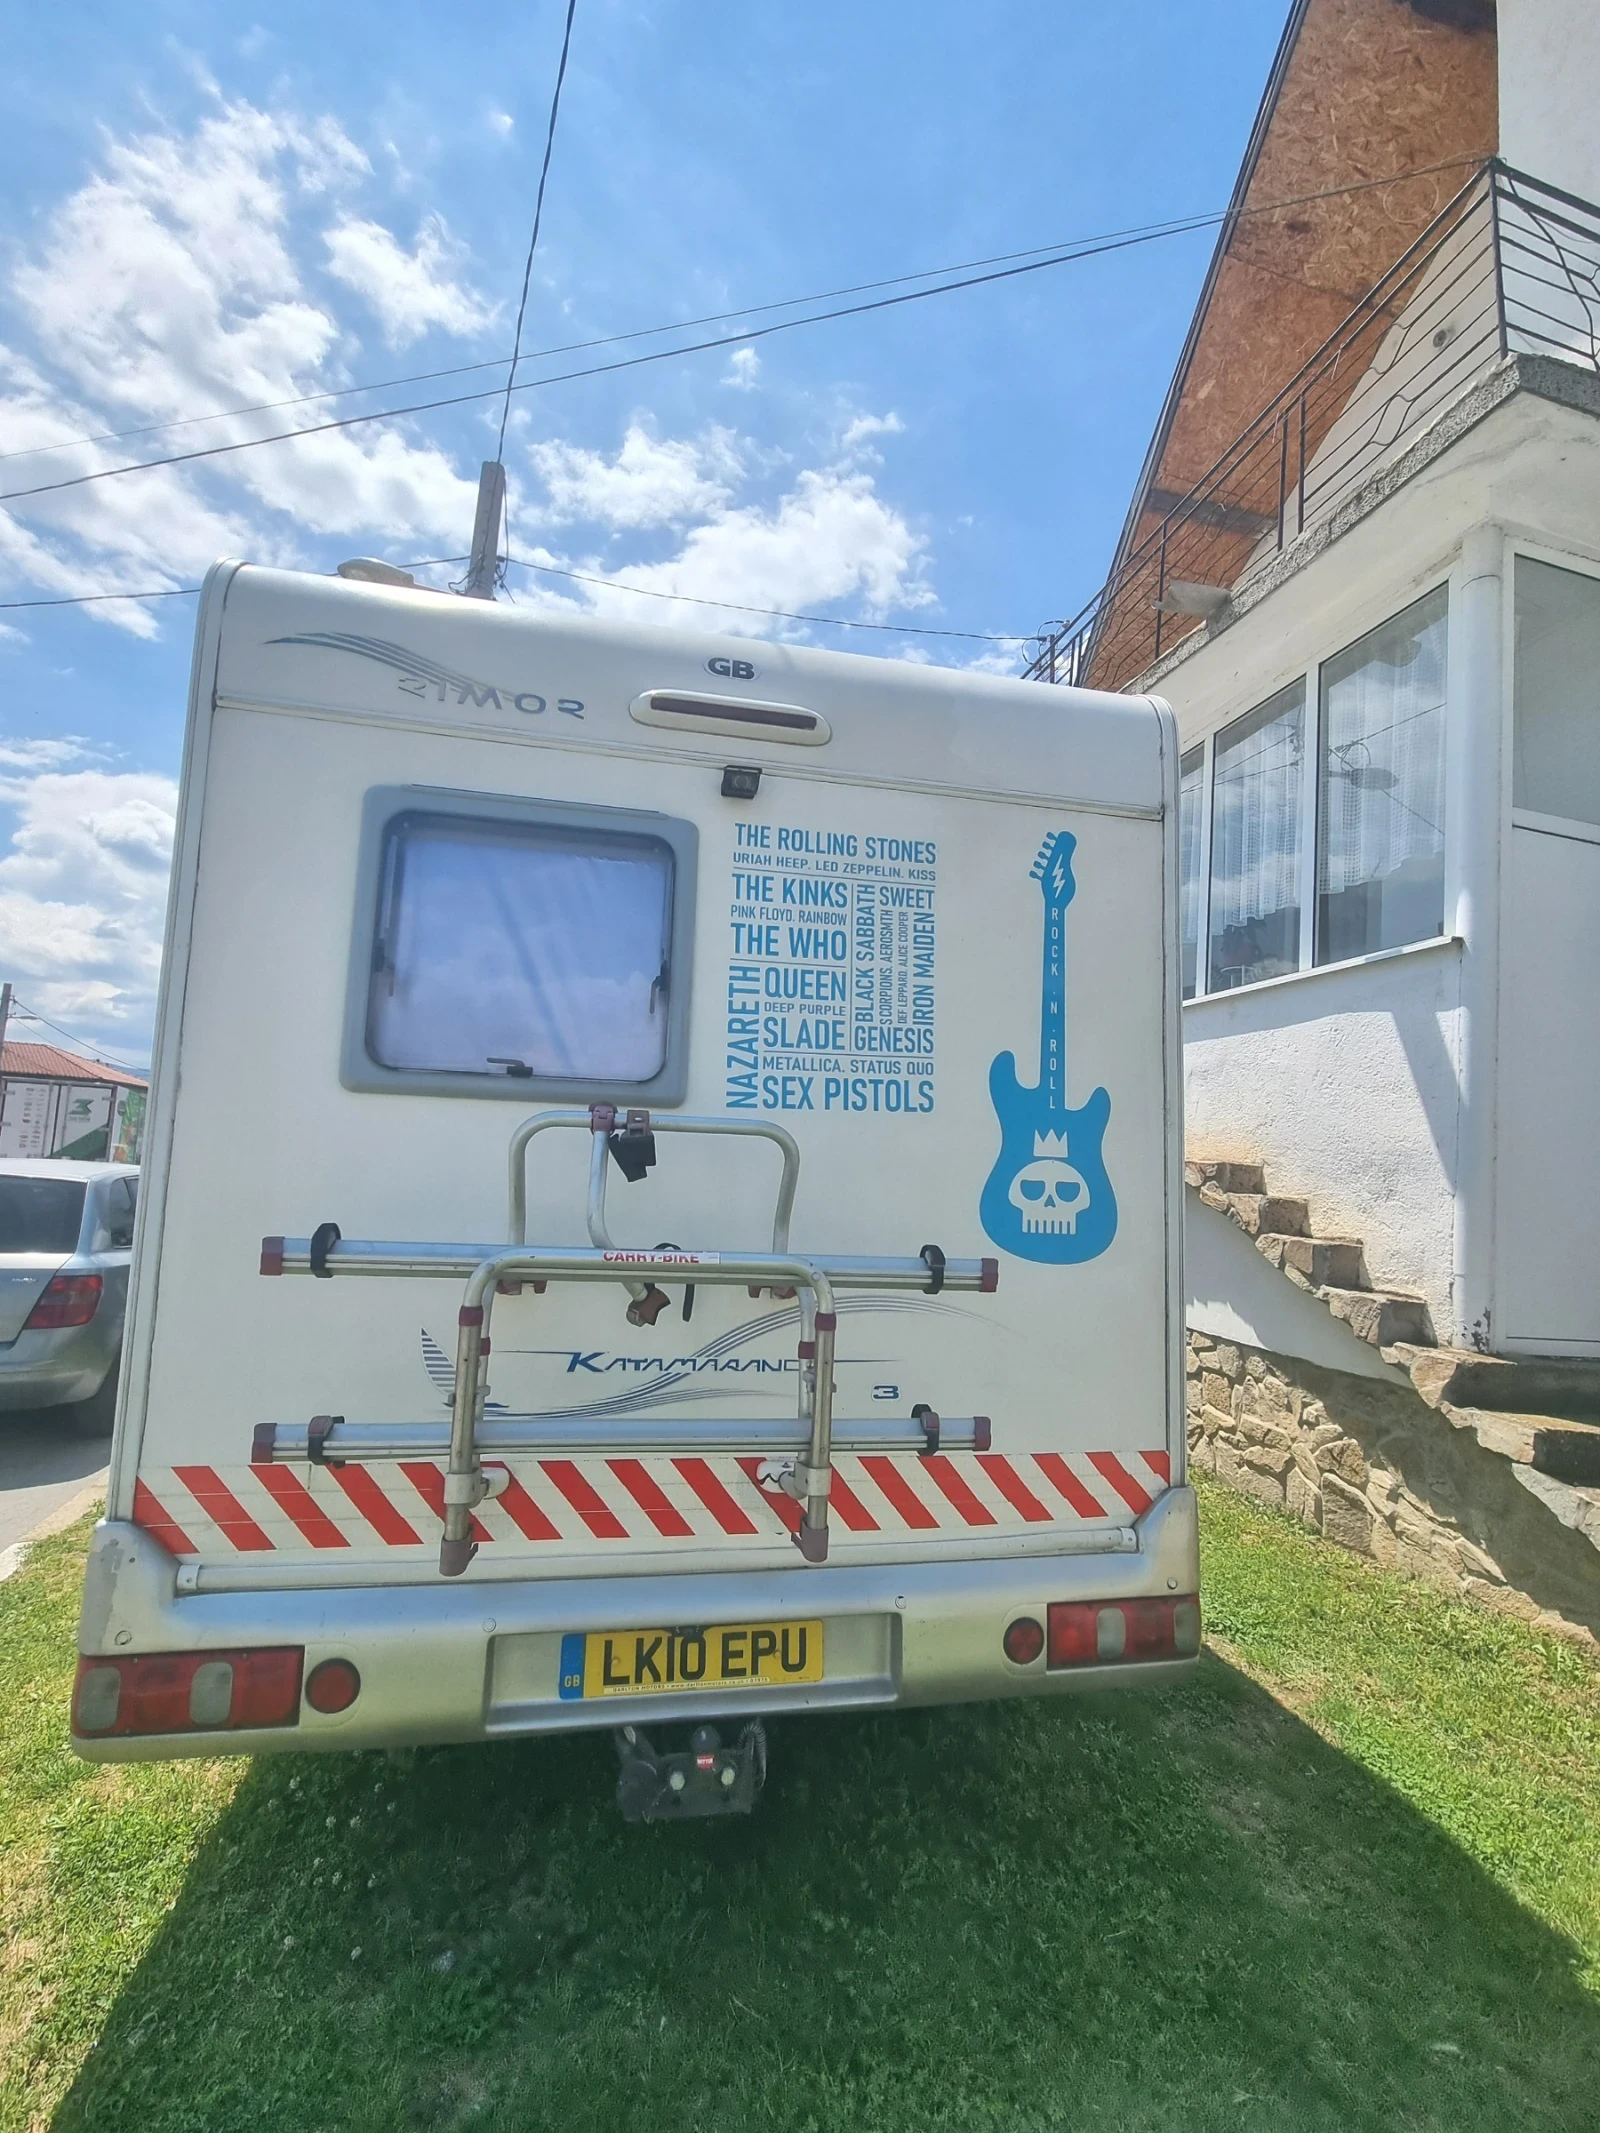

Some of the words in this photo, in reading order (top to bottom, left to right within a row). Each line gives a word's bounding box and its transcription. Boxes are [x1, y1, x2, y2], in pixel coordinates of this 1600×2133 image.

[707, 657, 755, 679] GB
[735, 823, 771, 848] THE
[778, 828, 858, 857] ROLLING
[865, 837, 936, 864] STONES
[733, 852, 772, 866] URIAH
[816, 861, 838, 872] LED
[908, 869, 936, 881] KISS
[732, 873, 775, 902] THE
[783, 878, 848, 908] KINKS
[879, 886, 935, 909] SWEET
[730, 905, 756, 919] PINK
[798, 910, 847, 926] RAINBOW
[856, 884, 875, 961] SABBATH
[899, 912, 908, 942] COOPER
[730, 923, 780, 956] THE
[789, 927, 847, 961] WHO
[898, 944, 908, 967] ALICE
[913, 912, 934, 978] MAIDEN
[1051, 907, 1059, 976] ROCK
[764, 967, 846, 1001] QUEEN
[855, 968, 874, 1022] BLACK
[764, 1002, 795, 1013] DEEP
[799, 1004, 846, 1016] PURPLE
[897, 1009, 907, 1024] DEF
[913, 985, 934, 1025] IRON
[726, 966, 760, 1109] NAZARETH
[763, 1017, 846, 1050] SLADE
[855, 1025, 934, 1054] GENESIS
[850, 1060, 901, 1074] STATUS
[906, 1062, 934, 1076] QUO
[1049, 1038, 1058, 1110] ROLL
[762, 1076, 814, 1110] SEX
[825, 1077, 934, 1113] PISTOLS
[873, 1385, 900, 1400] 3
[721, 1627, 807, 1678] EPU
[564, 1674, 581, 1688] GB
